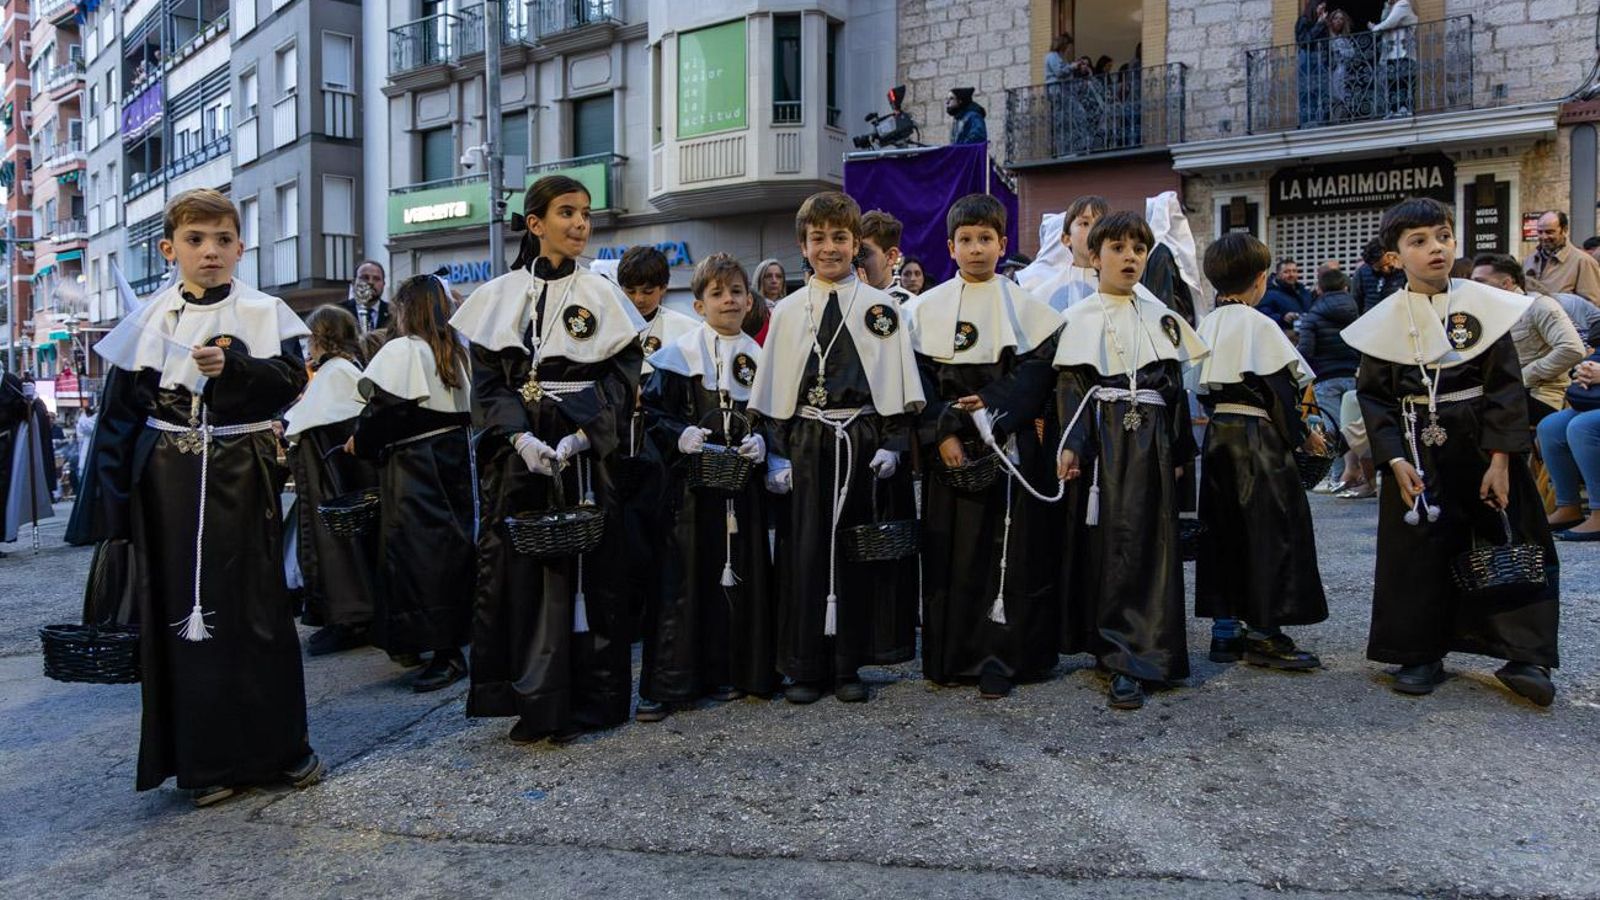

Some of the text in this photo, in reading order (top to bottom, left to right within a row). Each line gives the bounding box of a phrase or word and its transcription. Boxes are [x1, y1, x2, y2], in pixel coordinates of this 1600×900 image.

[683, 57, 697, 69] el
[684, 68, 723, 83] valor
[683, 88, 698, 99] de
[684, 101, 697, 113] la
[684, 107, 741, 127] actitud
[1280, 166, 1444, 201] LA MARIMORENA
[1484, 216, 1499, 224] VIVO
[1476, 241, 1497, 250] CIONES
